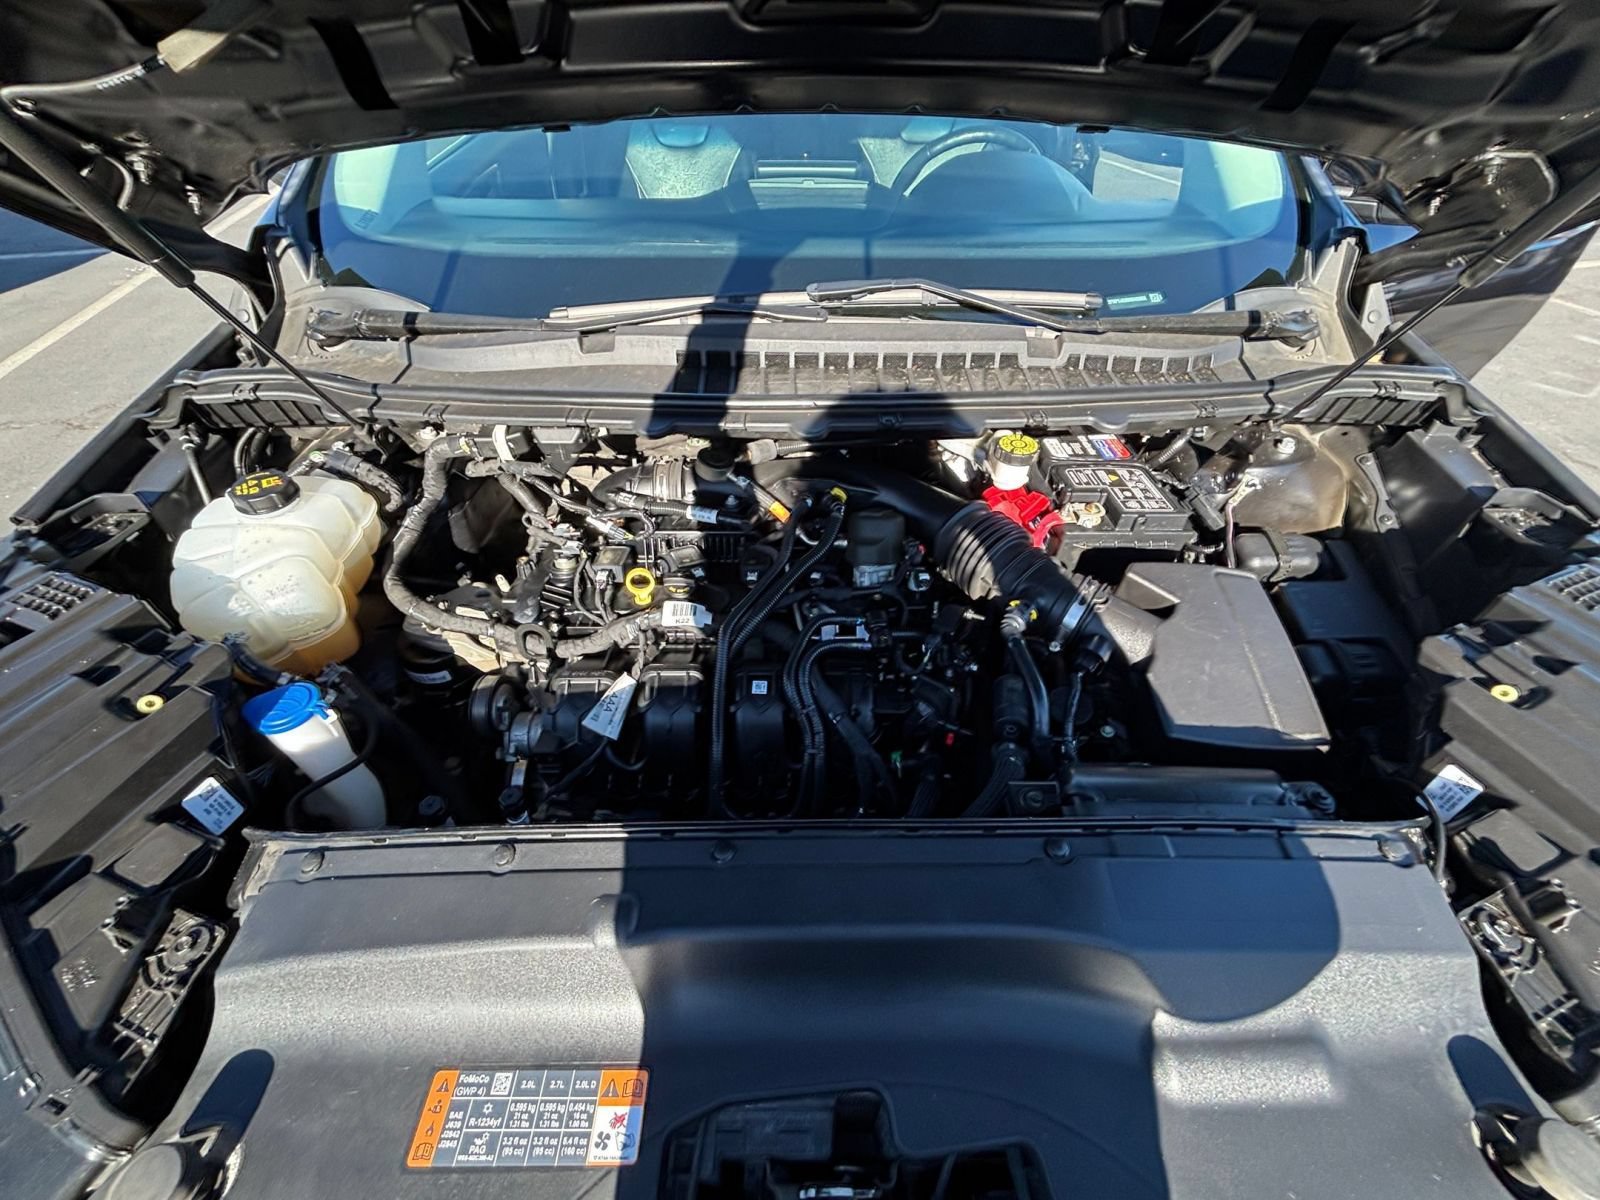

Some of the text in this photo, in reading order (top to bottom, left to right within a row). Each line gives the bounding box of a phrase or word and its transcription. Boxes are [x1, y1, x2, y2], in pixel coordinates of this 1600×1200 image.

[459, 1075, 490, 1083] FoMoCo
[454, 1087, 486, 1097] (GWP 4)
[528, 1103, 536, 1113] kg
[557, 1103, 566, 1113] kg
[587, 1103, 594, 1113] kg
[469, 1118, 502, 1128] R-1234yf
[503, 1137, 513, 1145] 3.2
[533, 1137, 543, 1145] 3.2
[469, 1146, 486, 1154] PAG
[514, 1148, 524, 1156] cc)
[544, 1148, 555, 1156] cc)
[576, 1148, 586, 1156] cc)
